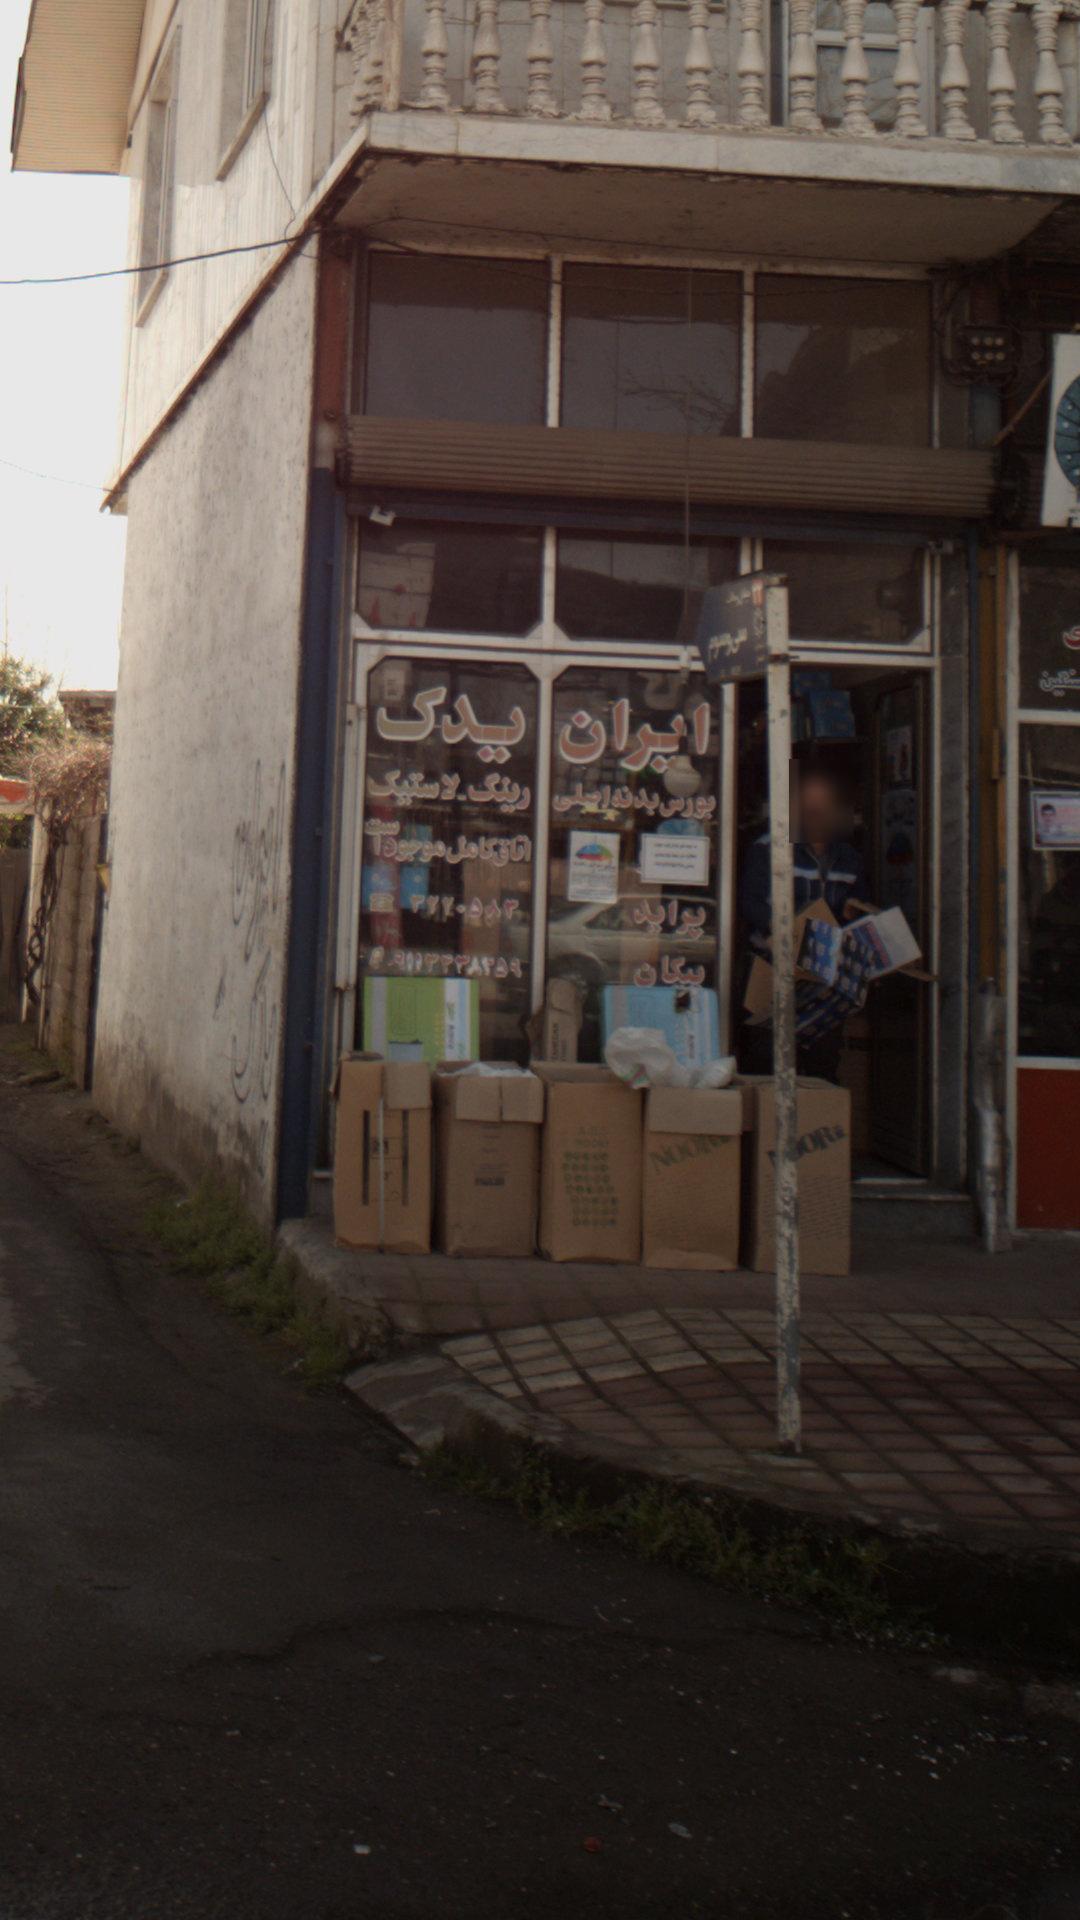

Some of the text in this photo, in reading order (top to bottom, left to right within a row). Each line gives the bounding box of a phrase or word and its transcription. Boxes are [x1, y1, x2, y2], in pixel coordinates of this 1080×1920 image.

[376, 686, 711, 772] ایران یدک
[366, 769, 461, 807] لاستیک
[467, 772, 532, 814] رینگ
[658, 794, 717, 820] بورس
[633, 899, 706, 939] پراید
